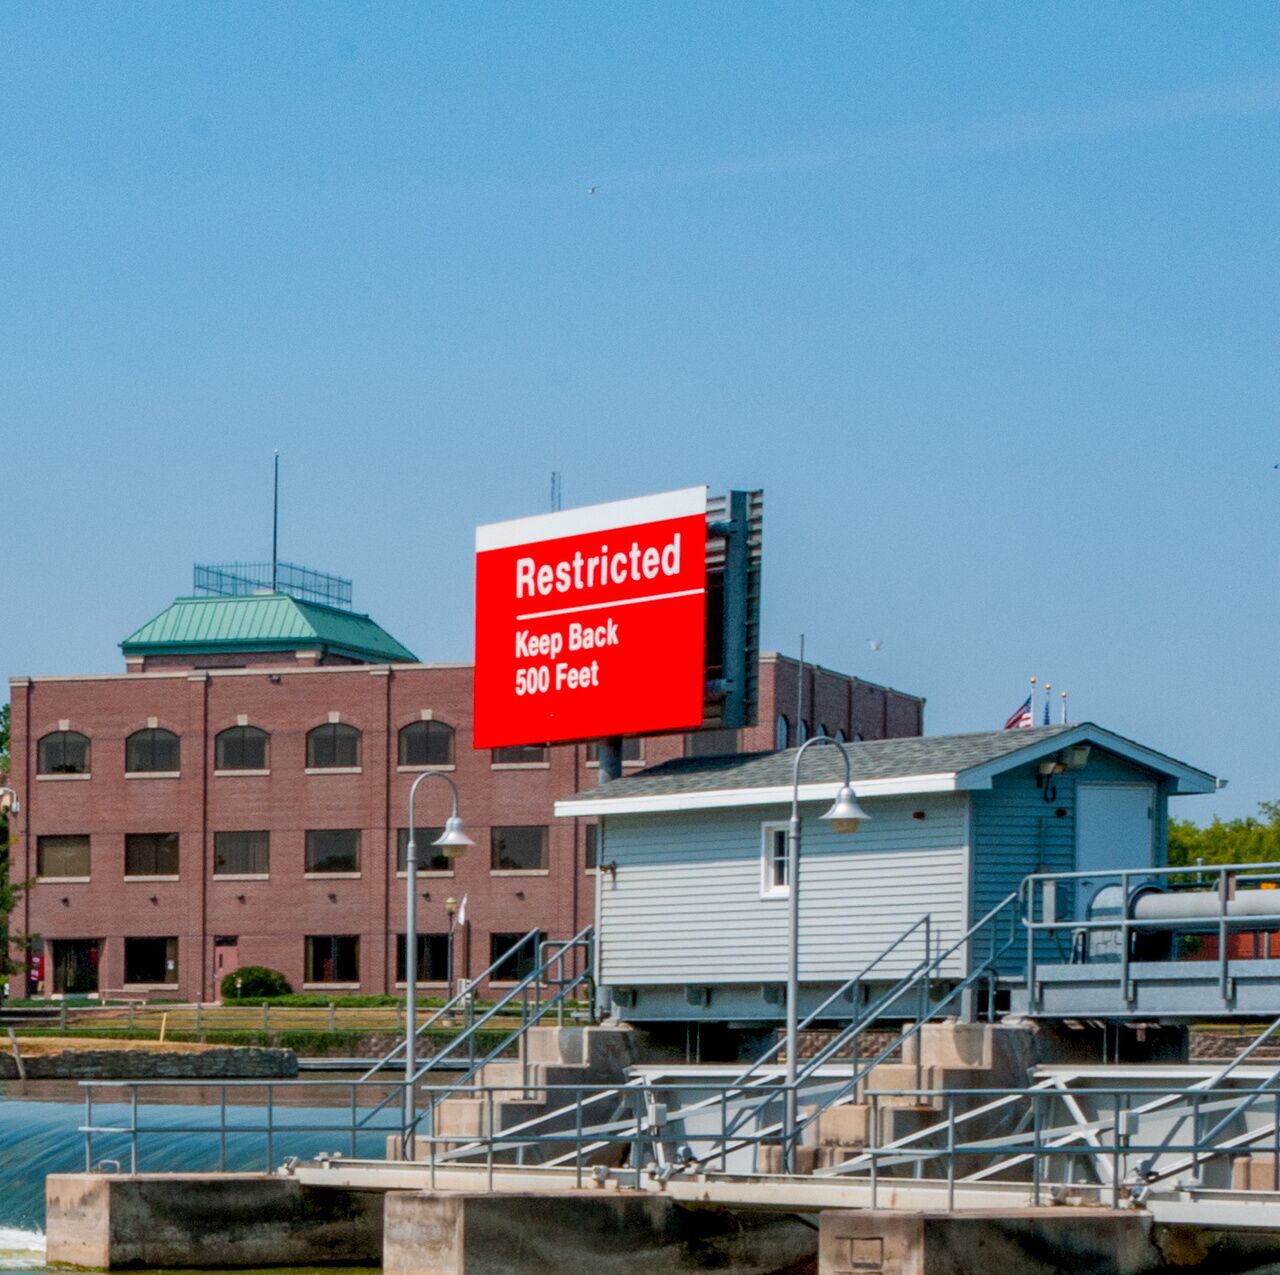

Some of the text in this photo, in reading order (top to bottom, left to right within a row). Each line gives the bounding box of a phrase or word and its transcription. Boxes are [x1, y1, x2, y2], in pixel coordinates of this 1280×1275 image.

[516, 532, 681, 599] Restricted
[515, 617, 619, 660] Keep Back
[515, 660, 599, 696] 500 Feet
